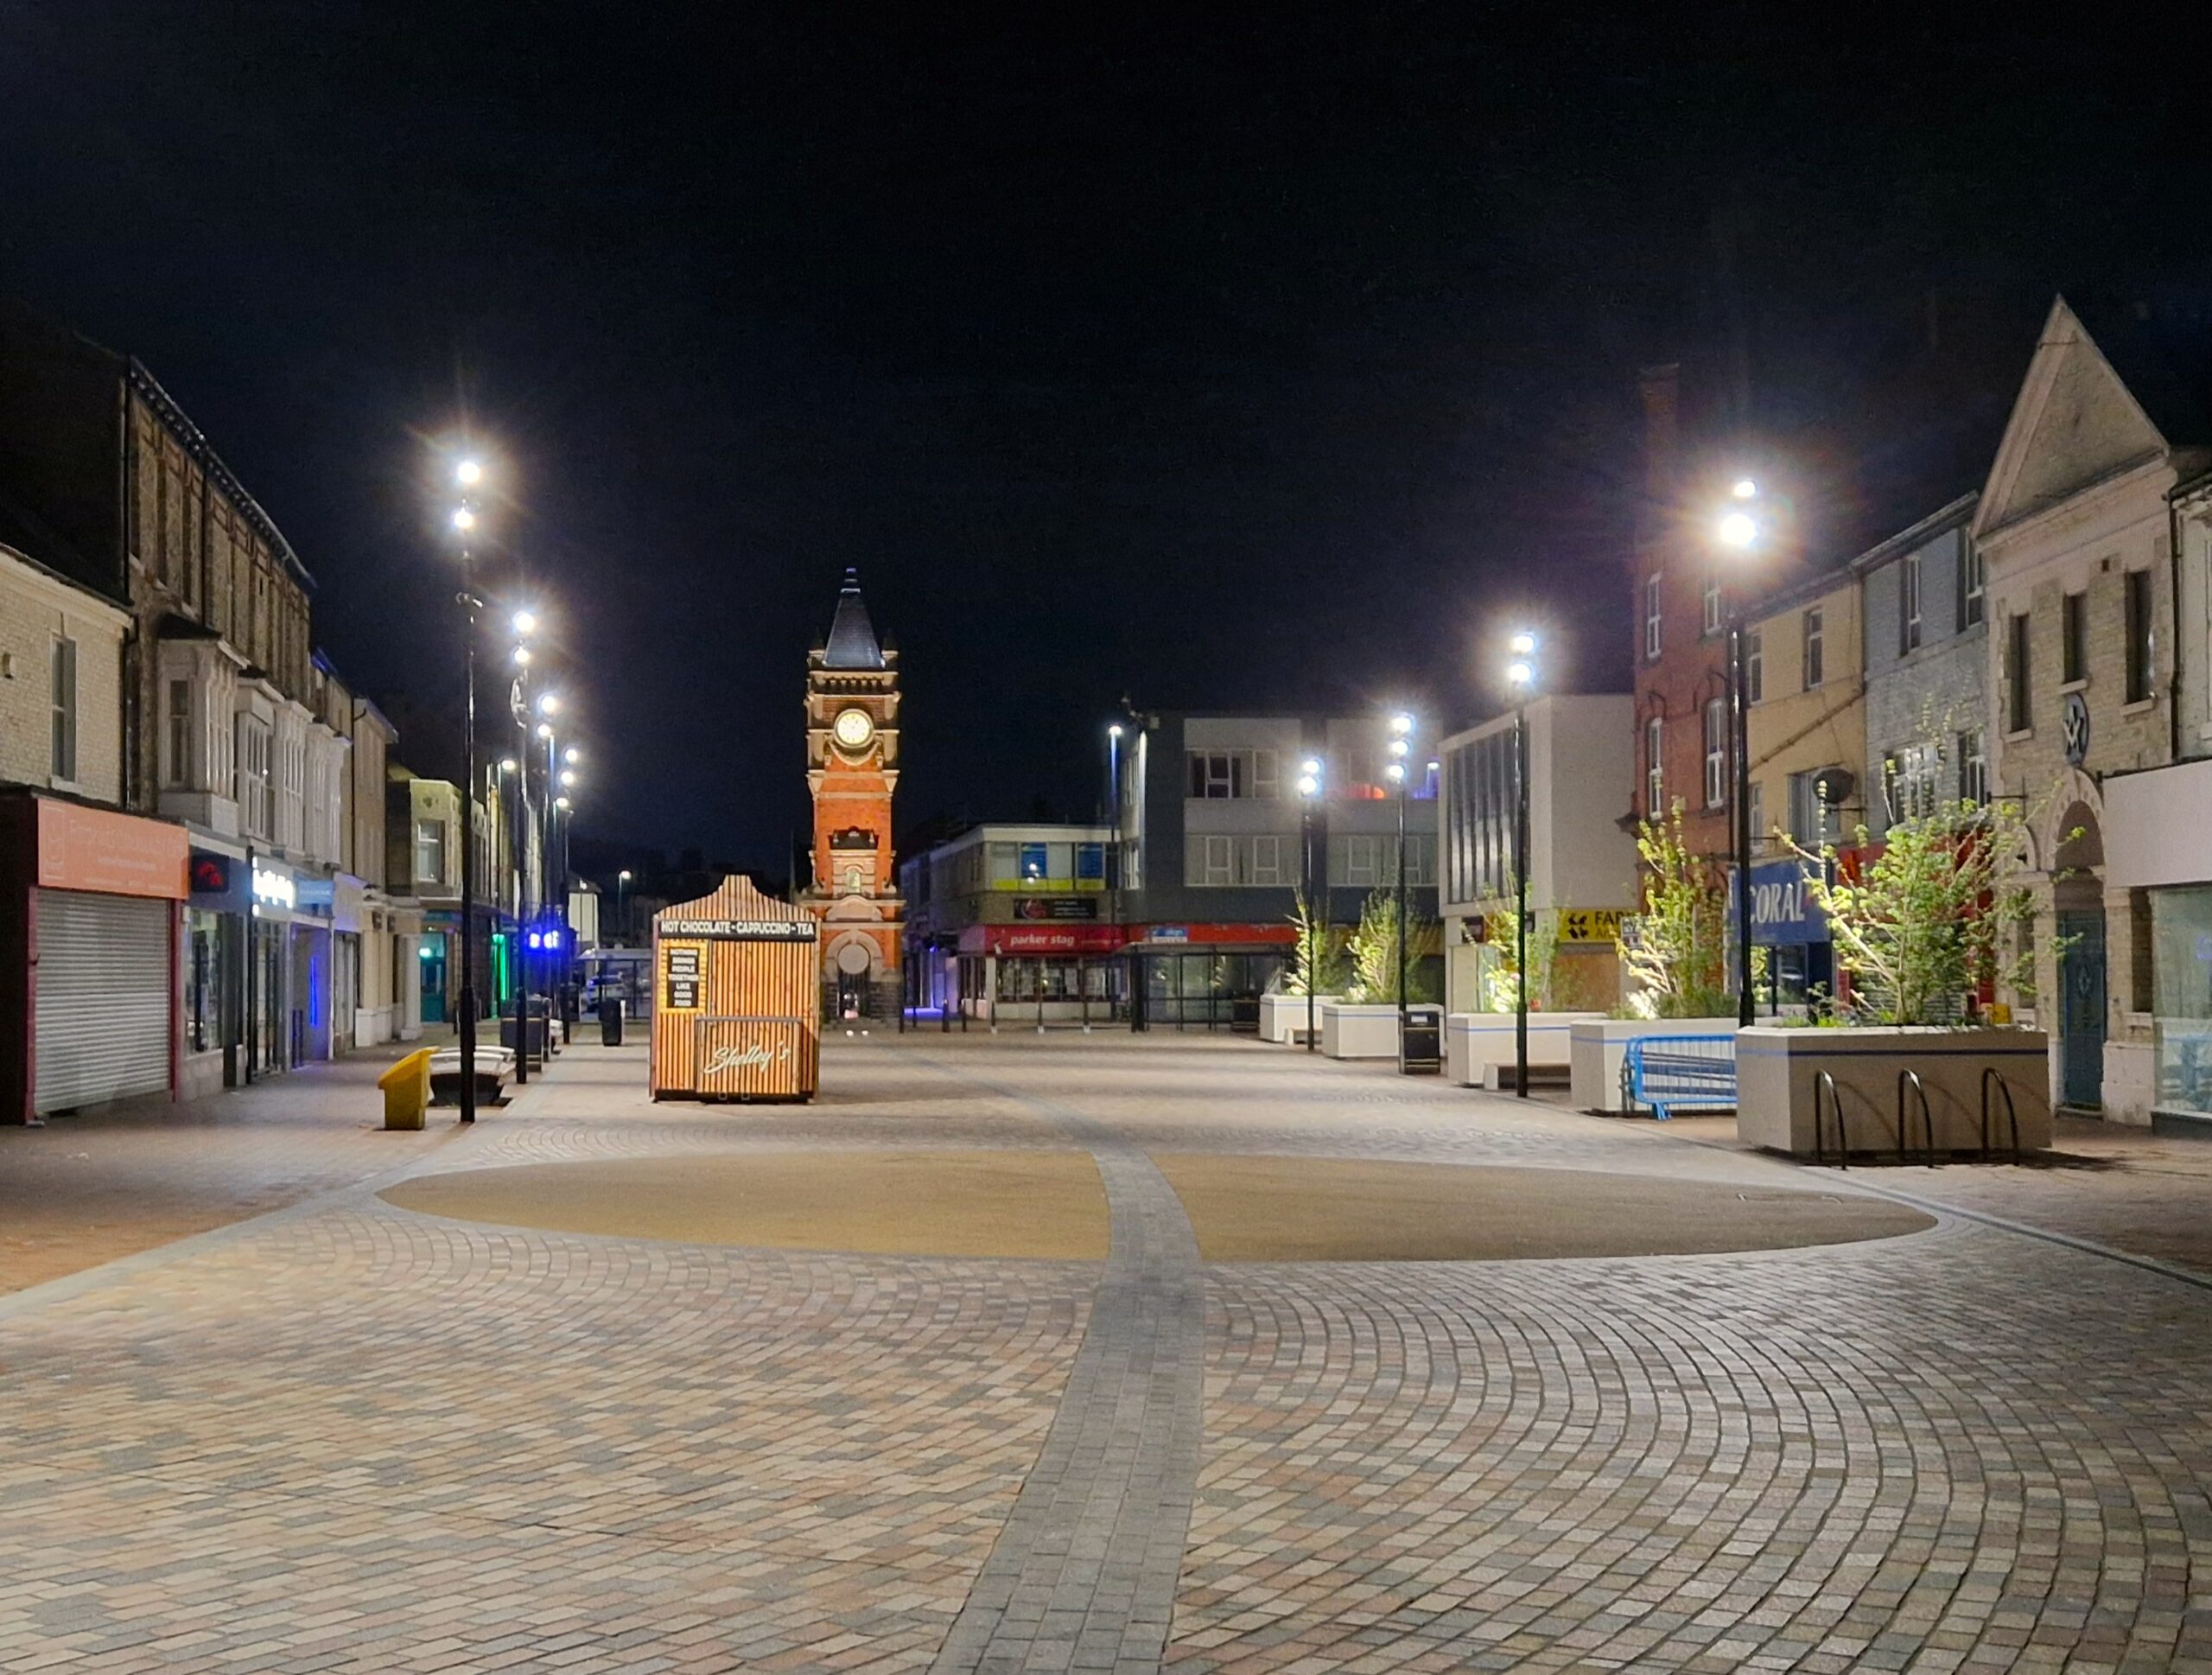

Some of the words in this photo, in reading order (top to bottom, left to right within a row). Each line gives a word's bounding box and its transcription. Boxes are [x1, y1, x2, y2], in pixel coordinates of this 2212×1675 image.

[661, 920, 678, 933] HOT
[681, 921, 731, 933] CHOCOLATE
[736, 921, 791, 934] CAPPUCCINO
[797, 923, 814, 935] TEA
[1010, 934, 1047, 946] parker
[1051, 934, 1075, 946] stag
